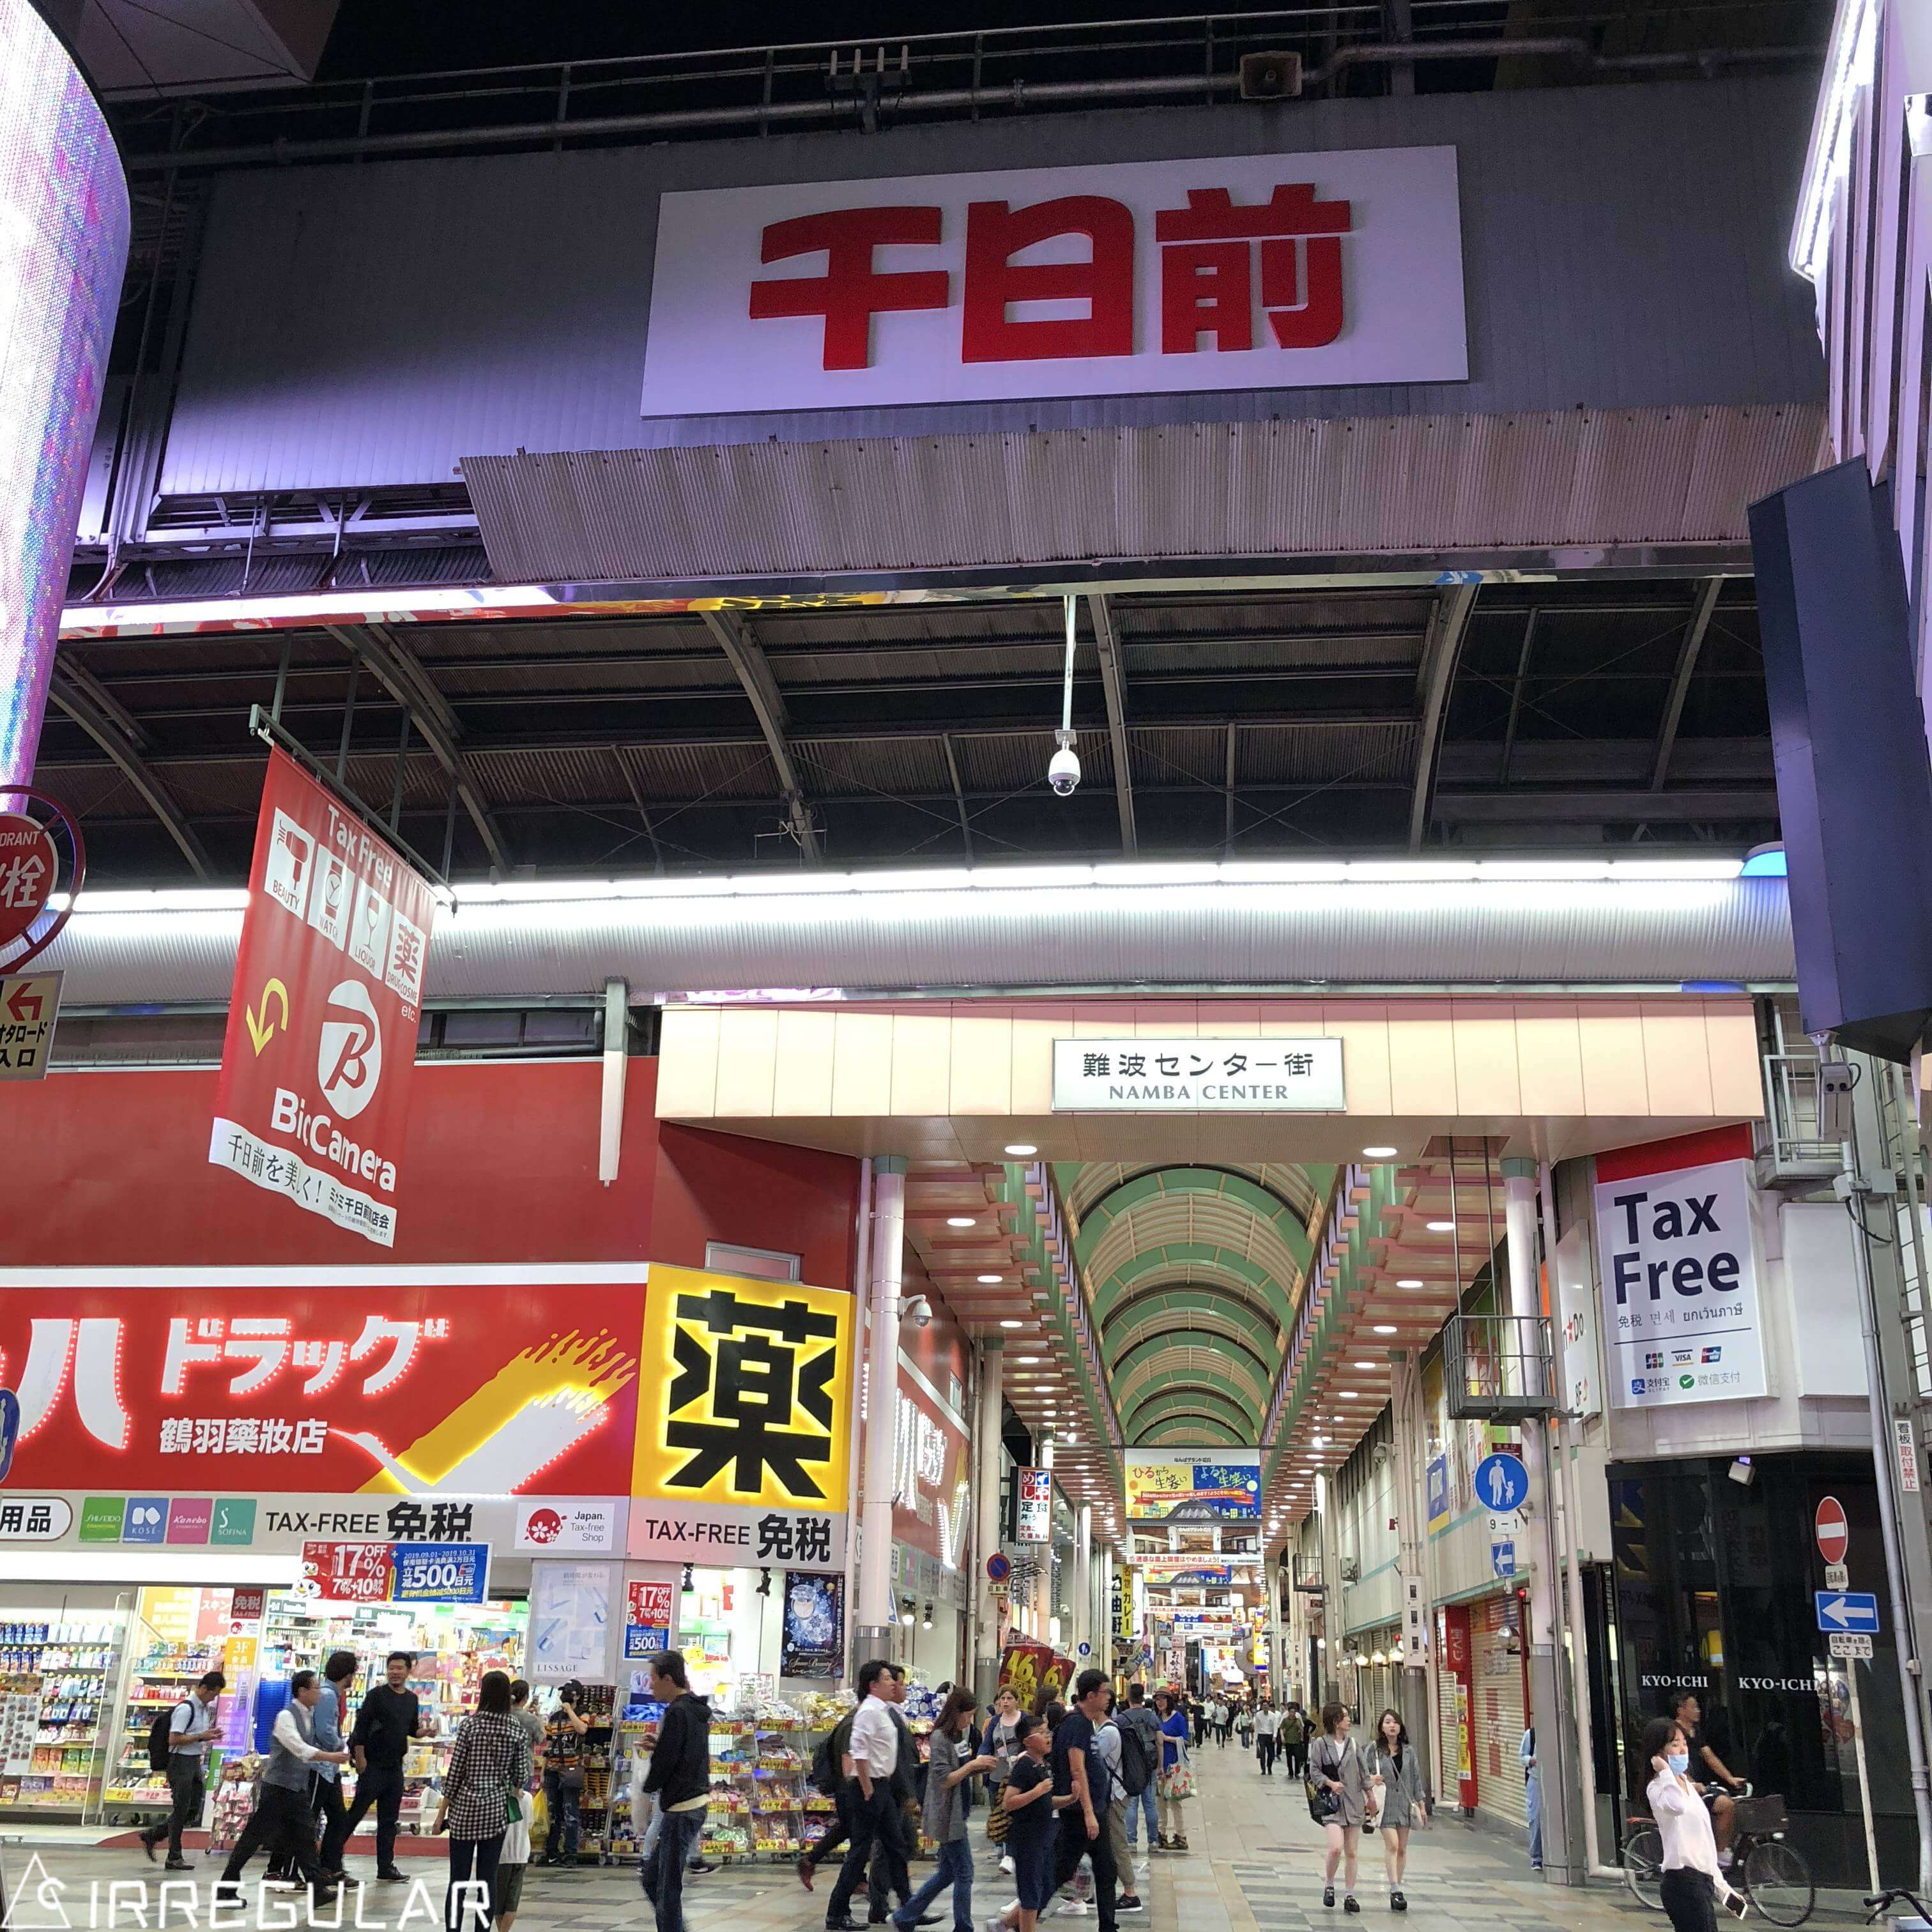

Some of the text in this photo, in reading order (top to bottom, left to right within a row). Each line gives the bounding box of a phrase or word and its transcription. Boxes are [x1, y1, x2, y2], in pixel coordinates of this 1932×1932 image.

[750, 183, 1351, 371] 千日前
[328, 804, 392, 889] Tax Free
[0, 855, 45, 908] 栓
[273, 878, 300, 910] BEAUTY
[355, 945, 376, 972] LIQUOR
[401, 1003, 417, 1023] etc.
[1084, 1052, 1314, 1077] 難波センター街
[1109, 1084, 1289, 1100] NAMBA CENTER
[271, 1087, 397, 1192] BicCamera
[1614, 1192, 1721, 1245] Tax
[1613, 1252, 1740, 1305] Free
[1618, 1302, 1744, 1328] 免税 면세 ยกเว้นภาษี
[161, 1315, 450, 1396] ドラッグ
[1646, 1377, 1670, 1388] 支付宝
[1698, 1372, 1741, 1386] 微信支付
[664, 1289, 838, 1499] 薬
[159, 1417, 328, 1455] 鶴羽藥妝店
[1897, 1422, 1917, 1489] 看板取付禁止
[173, 1515, 207, 1524] Kanebo
[574, 1512, 606, 1522] Japan.
[1021, 1501, 1048, 1513] 定食
[266, 1501, 474, 1541] TAX-FREE 免税
[570, 1523, 605, 1533] Tax-free
[582, 1533, 604, 1543] Shop
[646, 1514, 832, 1563] TAX-FREE 免税
[335, 1545, 365, 1577] 17
[365, 1545, 388, 1558] OFF
[412, 1564, 457, 1588] 500
[640, 1586, 658, 1607] 17
[657, 1587, 671, 1595] OFF
[634, 1636, 656, 1650] 500
[1832, 1646, 1871, 1657] ここまで
[1641, 1675, 1709, 1688] KYO-ICHI
[1738, 1677, 1819, 1691] KYO-ICHI
